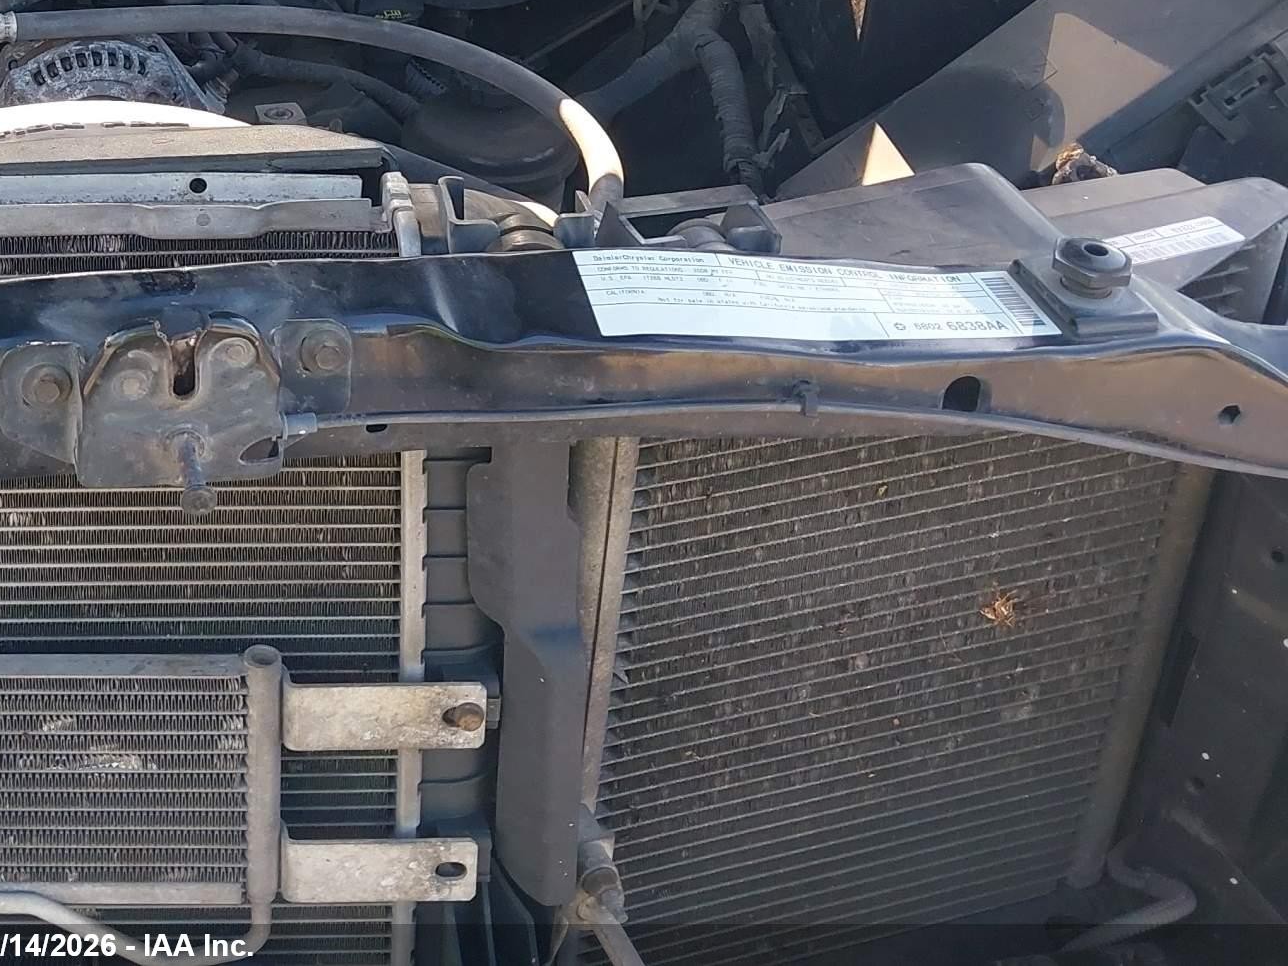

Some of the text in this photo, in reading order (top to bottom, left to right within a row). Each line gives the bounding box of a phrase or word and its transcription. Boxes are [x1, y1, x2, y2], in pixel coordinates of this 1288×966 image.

[728, 256, 962, 283] VEHICLE EMISSION CONTROL INFORMATION
[945, 319, 1010, 331] 6838AA
